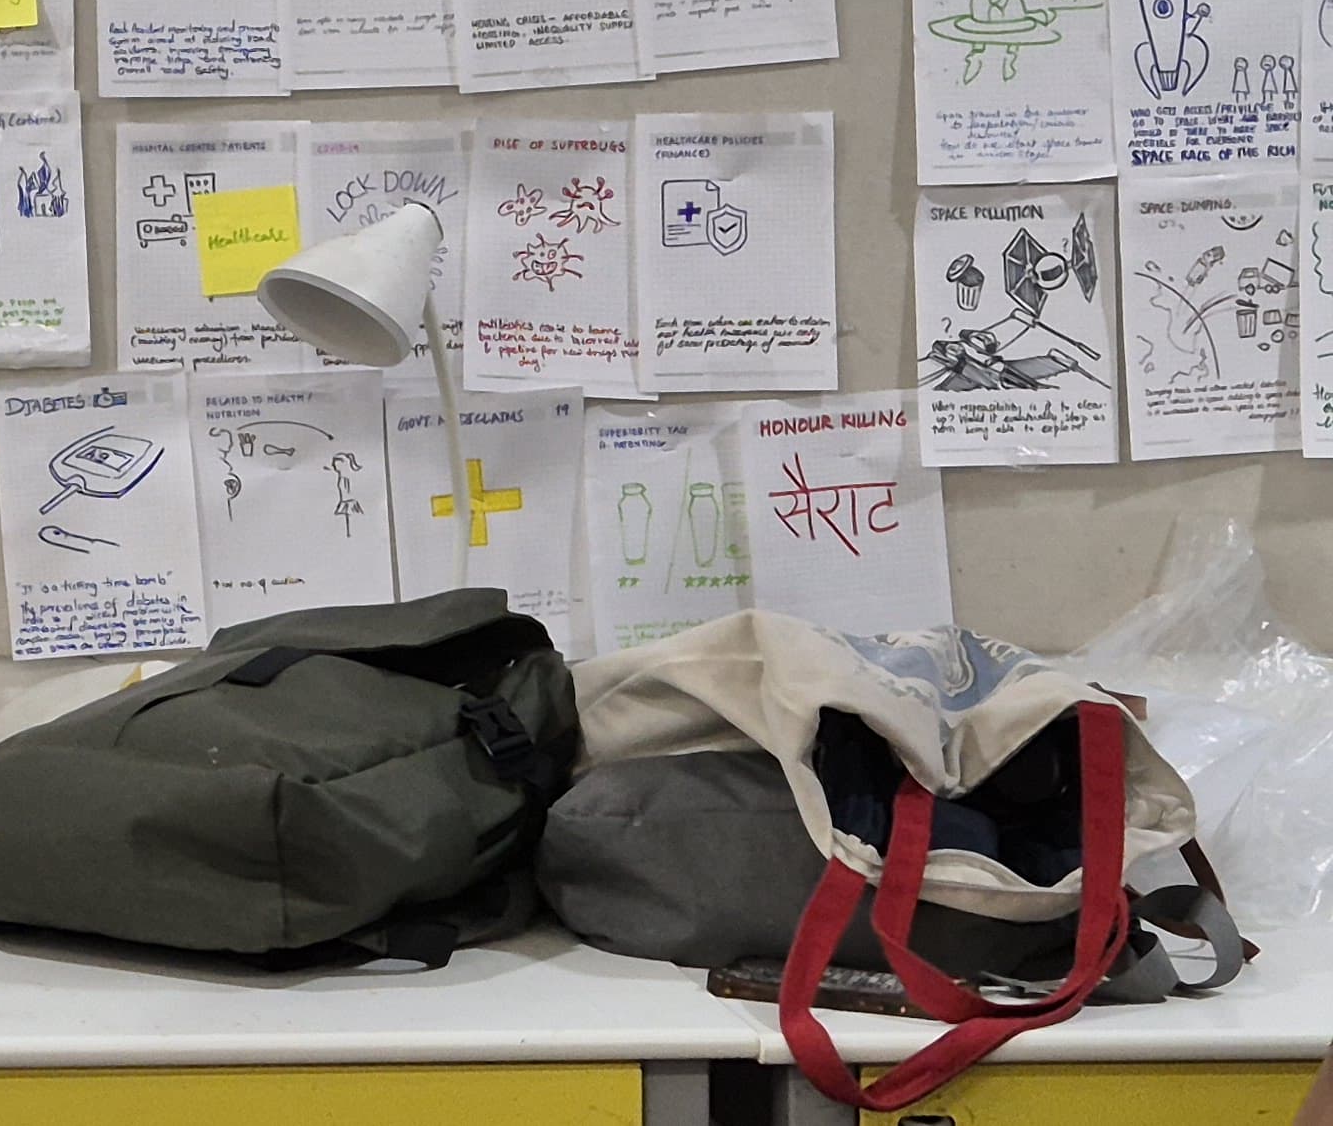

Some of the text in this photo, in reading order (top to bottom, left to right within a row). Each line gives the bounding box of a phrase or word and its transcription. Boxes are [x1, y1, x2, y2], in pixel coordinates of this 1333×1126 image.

[327, 169, 458, 224] LOCK DOWN
[930, 206, 968, 222] SPACE
[759, 409, 907, 438] HONOUR KILLING
